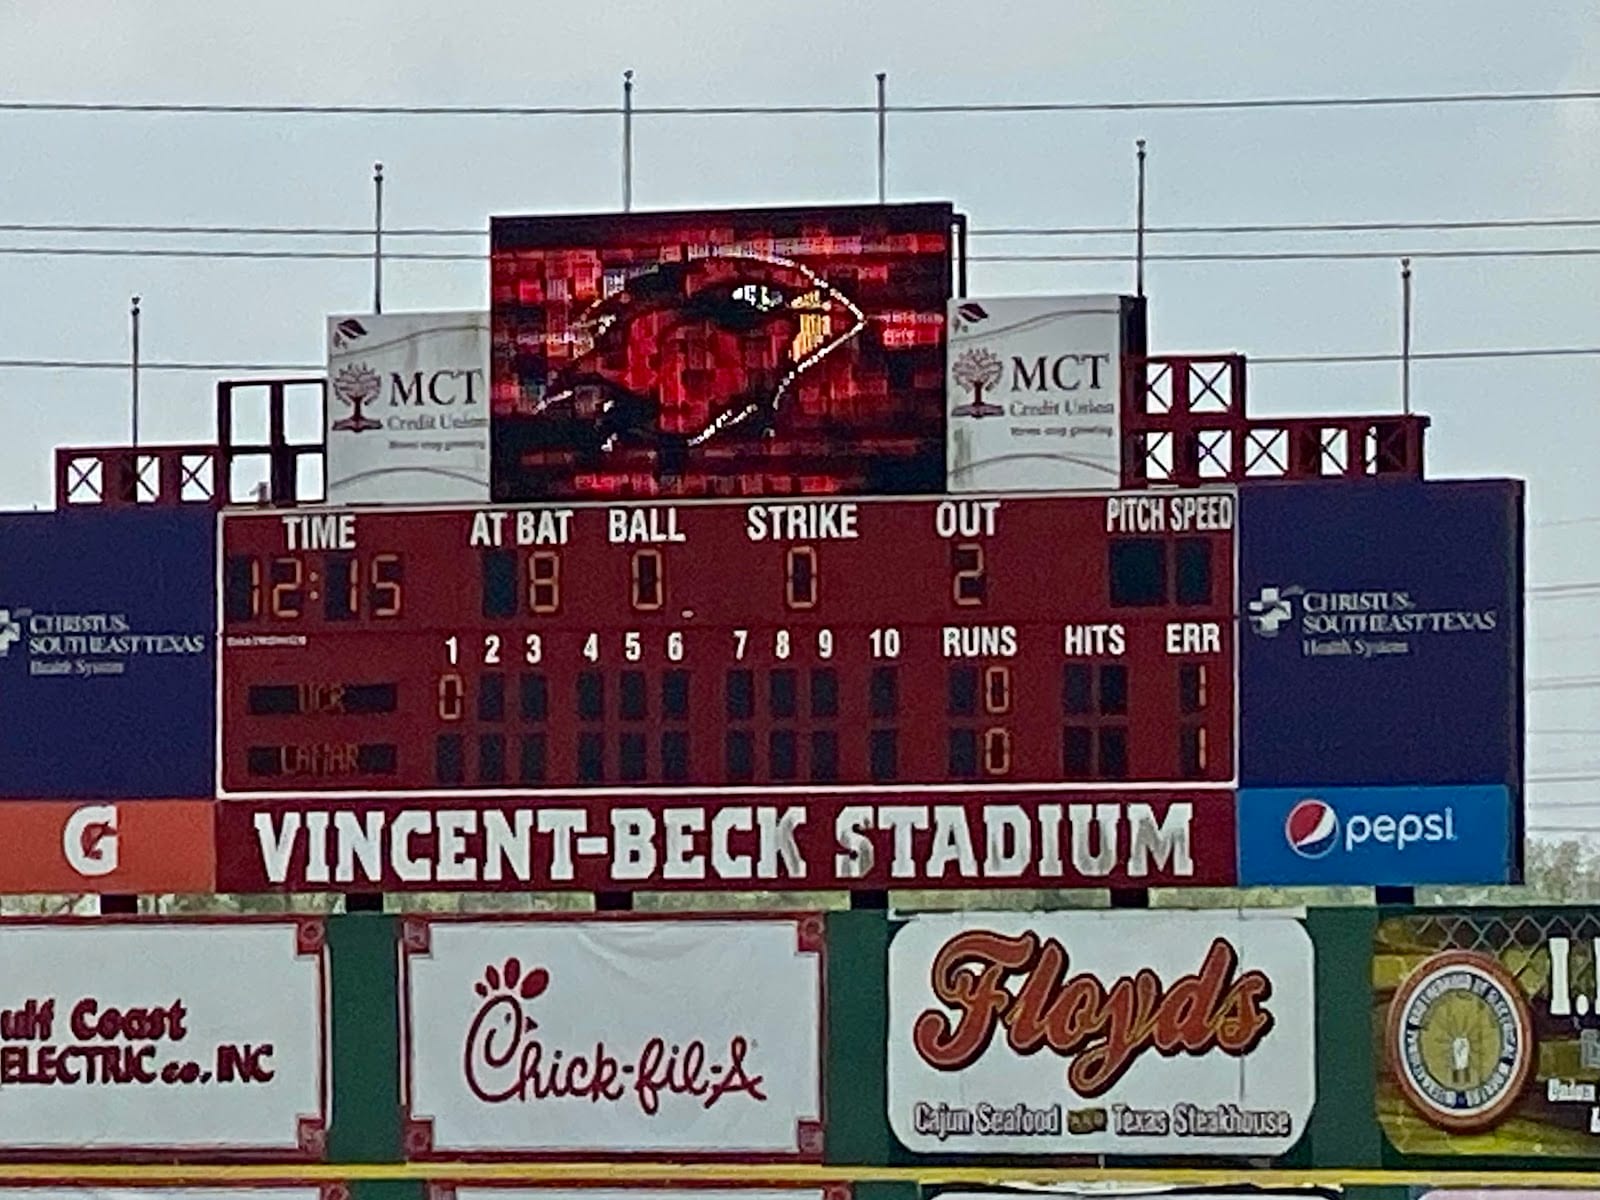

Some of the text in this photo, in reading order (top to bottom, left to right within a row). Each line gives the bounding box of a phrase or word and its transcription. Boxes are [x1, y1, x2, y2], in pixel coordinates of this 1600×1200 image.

[388, 367, 485, 407] MCT
[1010, 353, 1110, 392] MCT
[283, 514, 357, 550] TIME
[470, 510, 573, 546] AT BAT
[608, 508, 686, 543] BALL
[747, 503, 859, 540] STRIKE
[936, 502, 1000, 537] OUT
[1106, 496, 1233, 532] PITCH SPEED
[250, 553, 401, 618] 12:15
[528, 550, 561, 613] 8
[631, 549, 664, 611] 0
[786, 545, 818, 609] 0
[952, 543, 985, 606] 2
[1064, 624, 1125, 655] HITS
[1166, 623, 1221, 653] ERR
[1428, 611, 1496, 632] TEXAS
[444, 636, 459, 666] 1
[484, 635, 501, 664] 2
[525, 634, 543, 663] 3
[582, 633, 600, 662] 4
[624, 632, 642, 661] 5
[667, 632, 684, 661] 6
[732, 630, 749, 659] 7
[775, 630, 791, 658] 8
[818, 629, 834, 657] 9
[869, 629, 902, 657] 10
[942, 626, 1018, 657] RUNS
[438, 674, 464, 721] 0
[985, 666, 1010, 714] 0
[985, 727, 1010, 775] 0
[252, 803, 1195, 884] VINCENT-BECK STADIUM
[1345, 806, 1456, 851] pepsi
[71, 998, 188, 1041] Coast
[913, 929, 1275, 1098] Floyds
[0, 1045, 157, 1084] ELECTRIC
[465, 994, 768, 1116] Chick-fil-A
[914, 1103, 974, 1141] Cajun
[976, 1103, 1061, 1138] Seafood
[1111, 1103, 1170, 1138] Texas
[1172, 1103, 1292, 1138] Steakhouse
